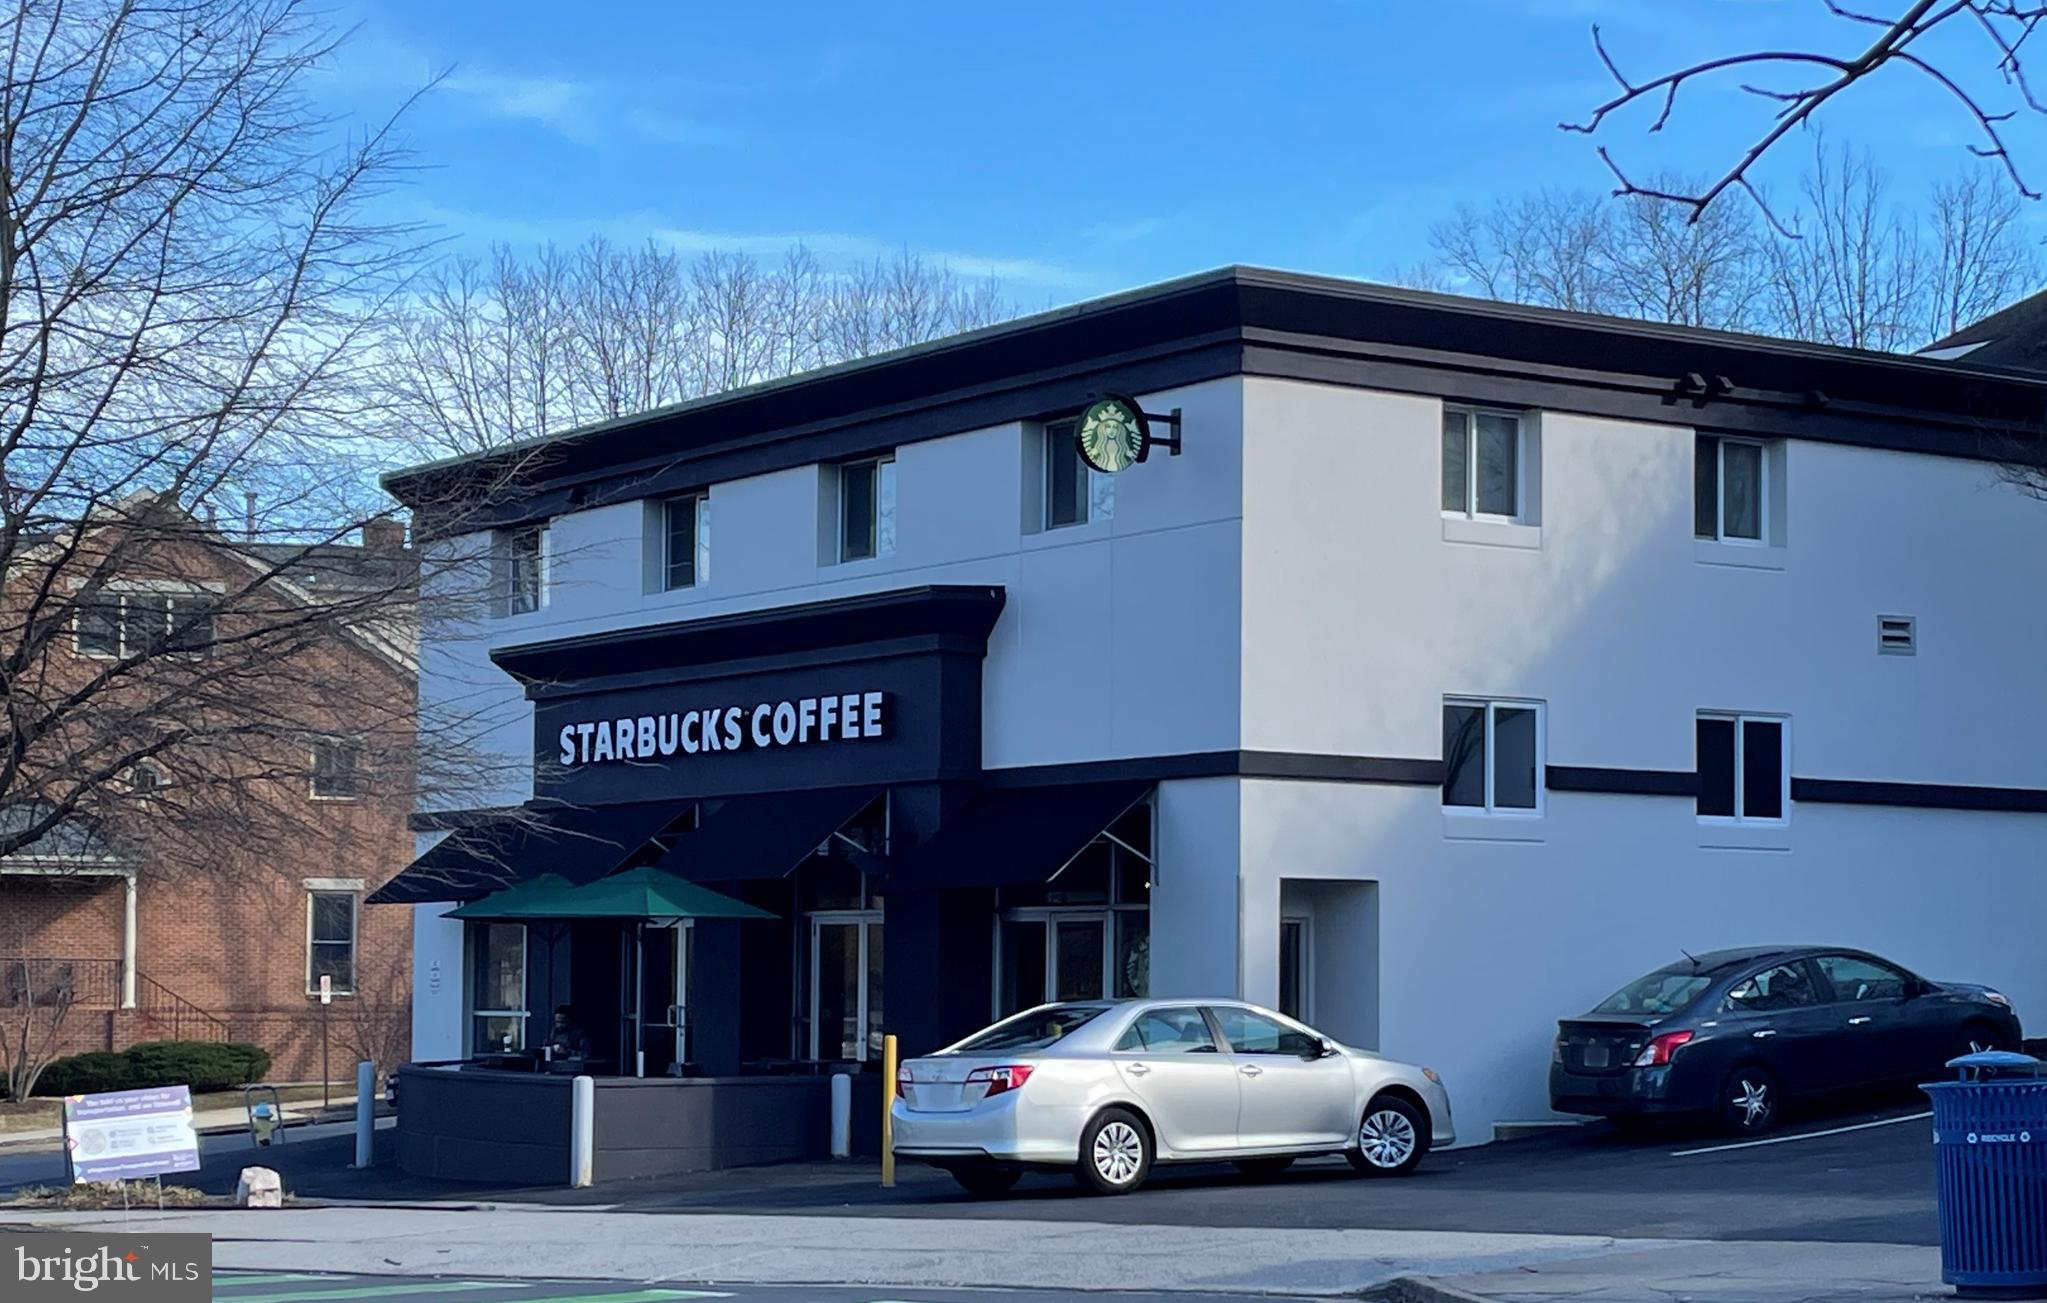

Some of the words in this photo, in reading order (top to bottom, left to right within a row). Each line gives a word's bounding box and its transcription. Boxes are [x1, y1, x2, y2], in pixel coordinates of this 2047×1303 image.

[559, 706, 742, 766] STARBUCKS
[751, 691, 883, 748] COFFEE
[1981, 1133, 2016, 1142] RECYCLE
